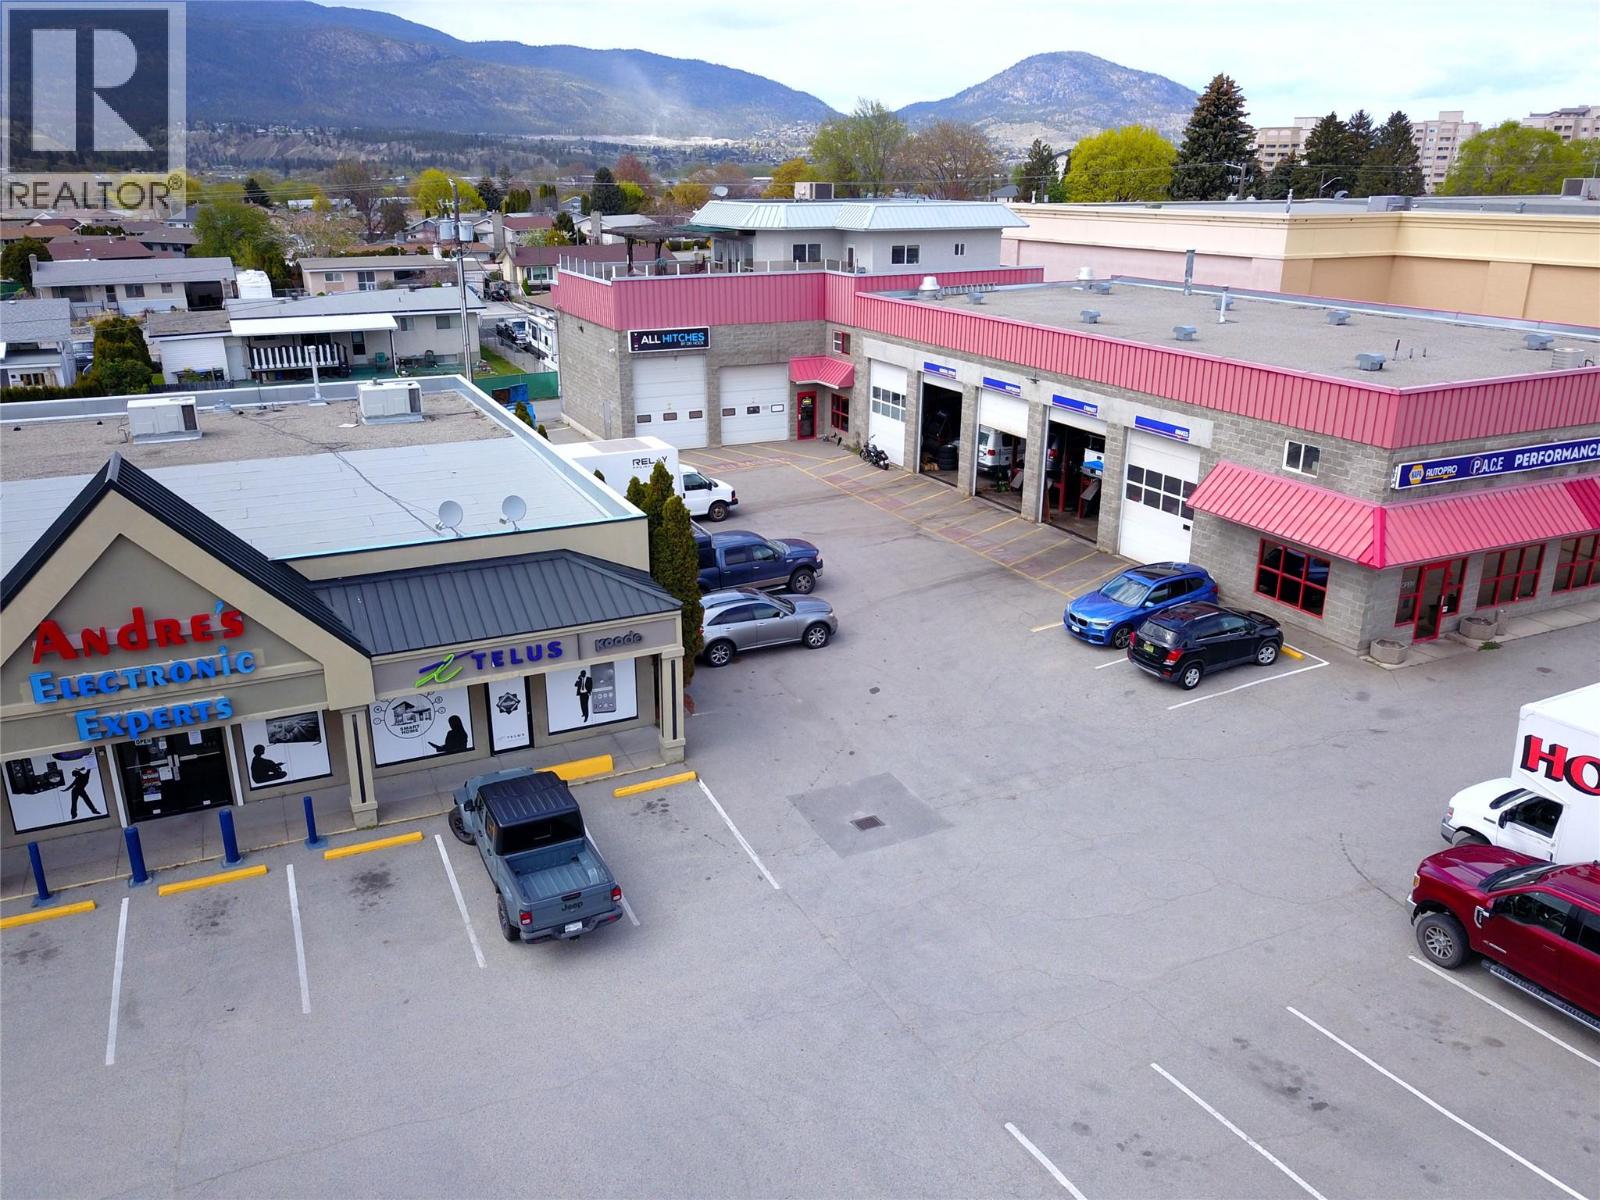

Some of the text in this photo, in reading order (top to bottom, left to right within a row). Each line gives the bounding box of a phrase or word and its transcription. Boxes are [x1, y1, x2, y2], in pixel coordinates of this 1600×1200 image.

[641, 332, 705, 344] ALL HITCHES
[632, 455, 668, 466] RELY
[1426, 465, 1458, 477] AUTOPRO
[471, 640, 564, 670] TELUS
[561, 901, 584, 911] Jeep
